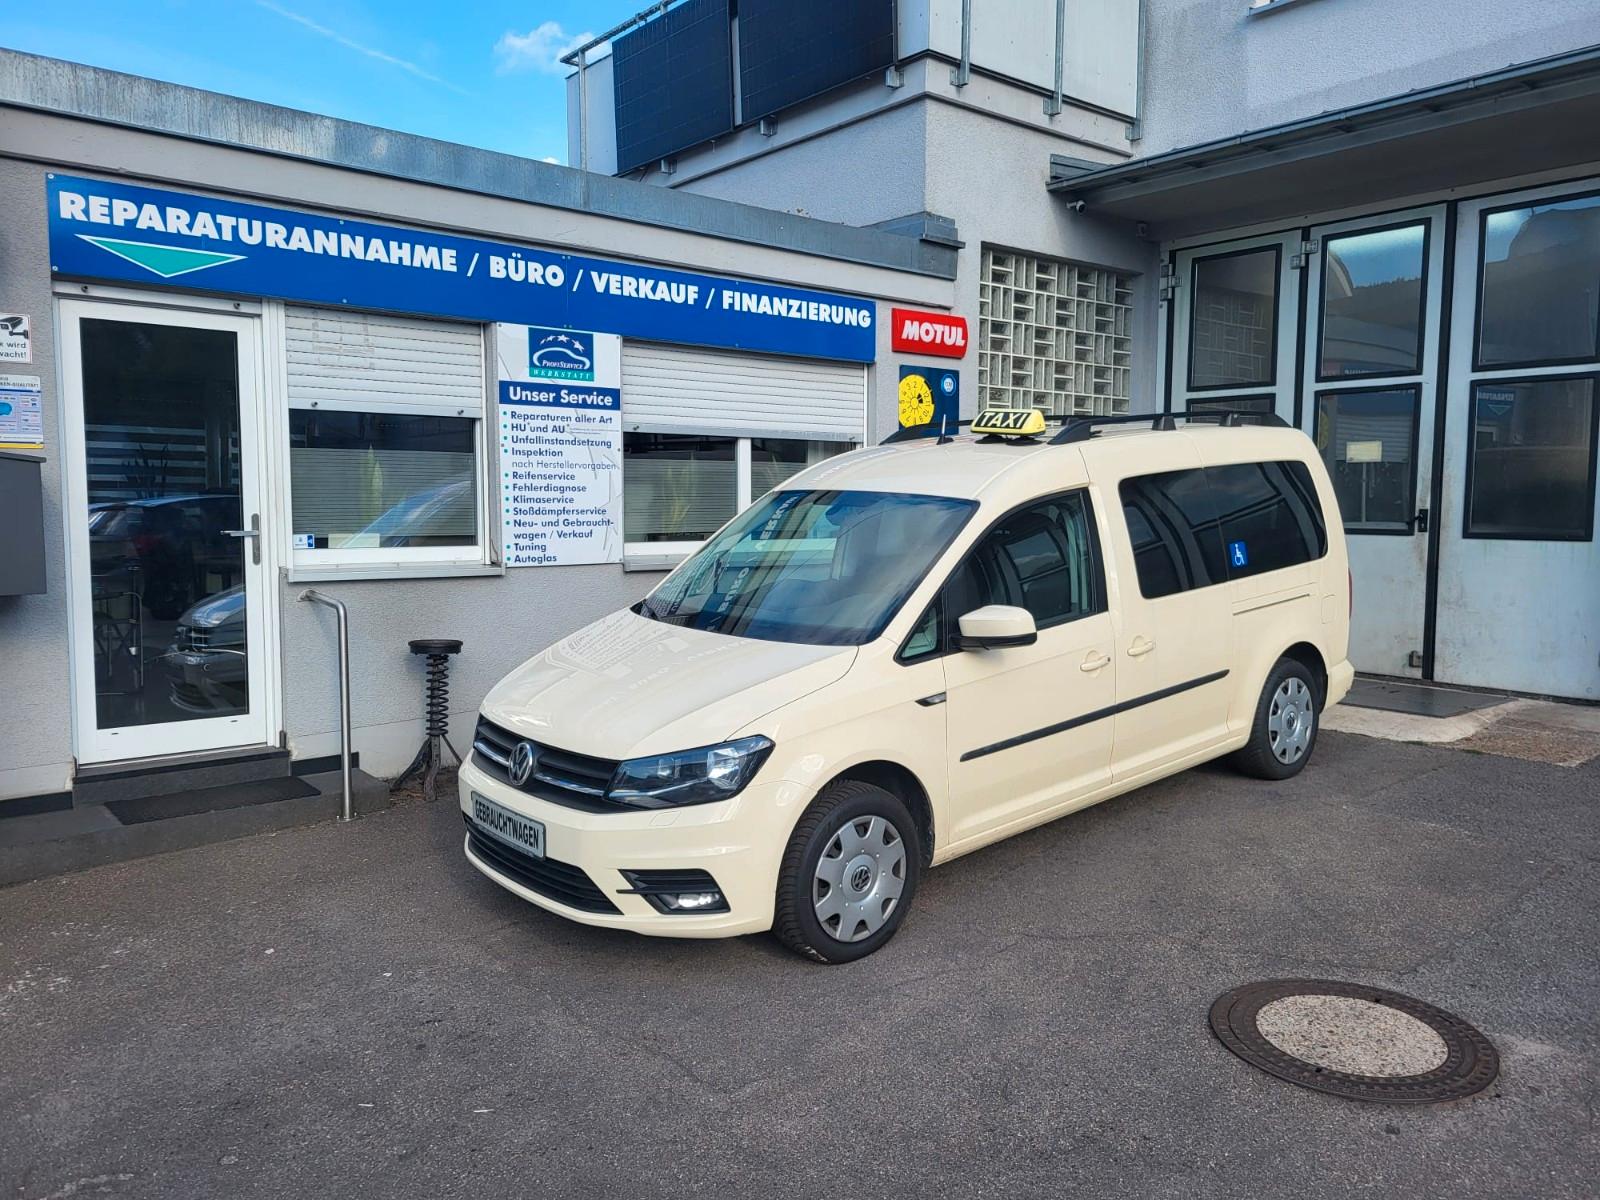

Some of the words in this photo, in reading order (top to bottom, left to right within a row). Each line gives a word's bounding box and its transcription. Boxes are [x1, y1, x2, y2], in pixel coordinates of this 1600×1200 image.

[59, 190, 458, 273] REPARATURANNAHME
[467, 252, 479, 277] /
[489, 252, 565, 287] BÜRO
[573, 269, 584, 292] /
[591, 271, 699, 305] VERKAUF
[705, 288, 716, 309] /
[722, 290, 872, 328] FINANZIERUNG
[901, 319, 967, 347] MOTUL
[533, 369, 590, 379] WERKSTATT
[509, 386, 556, 402] Unser
[560, 389, 613, 406] Service
[510, 411, 572, 423] Reparaturen
[575, 414, 597, 424] aller
[598, 415, 613, 424] Art
[980, 412, 1029, 428] TAXI
[511, 423, 527, 432] HU
[529, 424, 549, 433] und
[551, 425, 566, 434] AU
[511, 435, 612, 449] Unfallinstandsetzung
[511, 447, 564, 458] Inspektion
[511, 460, 534, 468] nach
[536, 461, 617, 471] Herstellervorgaben
[512, 471, 576, 481] Reifenservice
[512, 483, 588, 494] Fehlerdiagnose
[513, 495, 575, 504] Klimaservice
[513, 506, 607, 517] Stoßdämpferservice
[513, 519, 538, 528] Neu-
[541, 518, 560, 527] und
[562, 518, 614, 527] Gebraucht-
[513, 531, 547, 541] wagen
[556, 529, 593, 538] Verkauf
[513, 542, 547, 552] Tuning
[514, 554, 557, 564] Autoglas
[474, 799, 540, 850] GEBRAUCHTWAGEN
